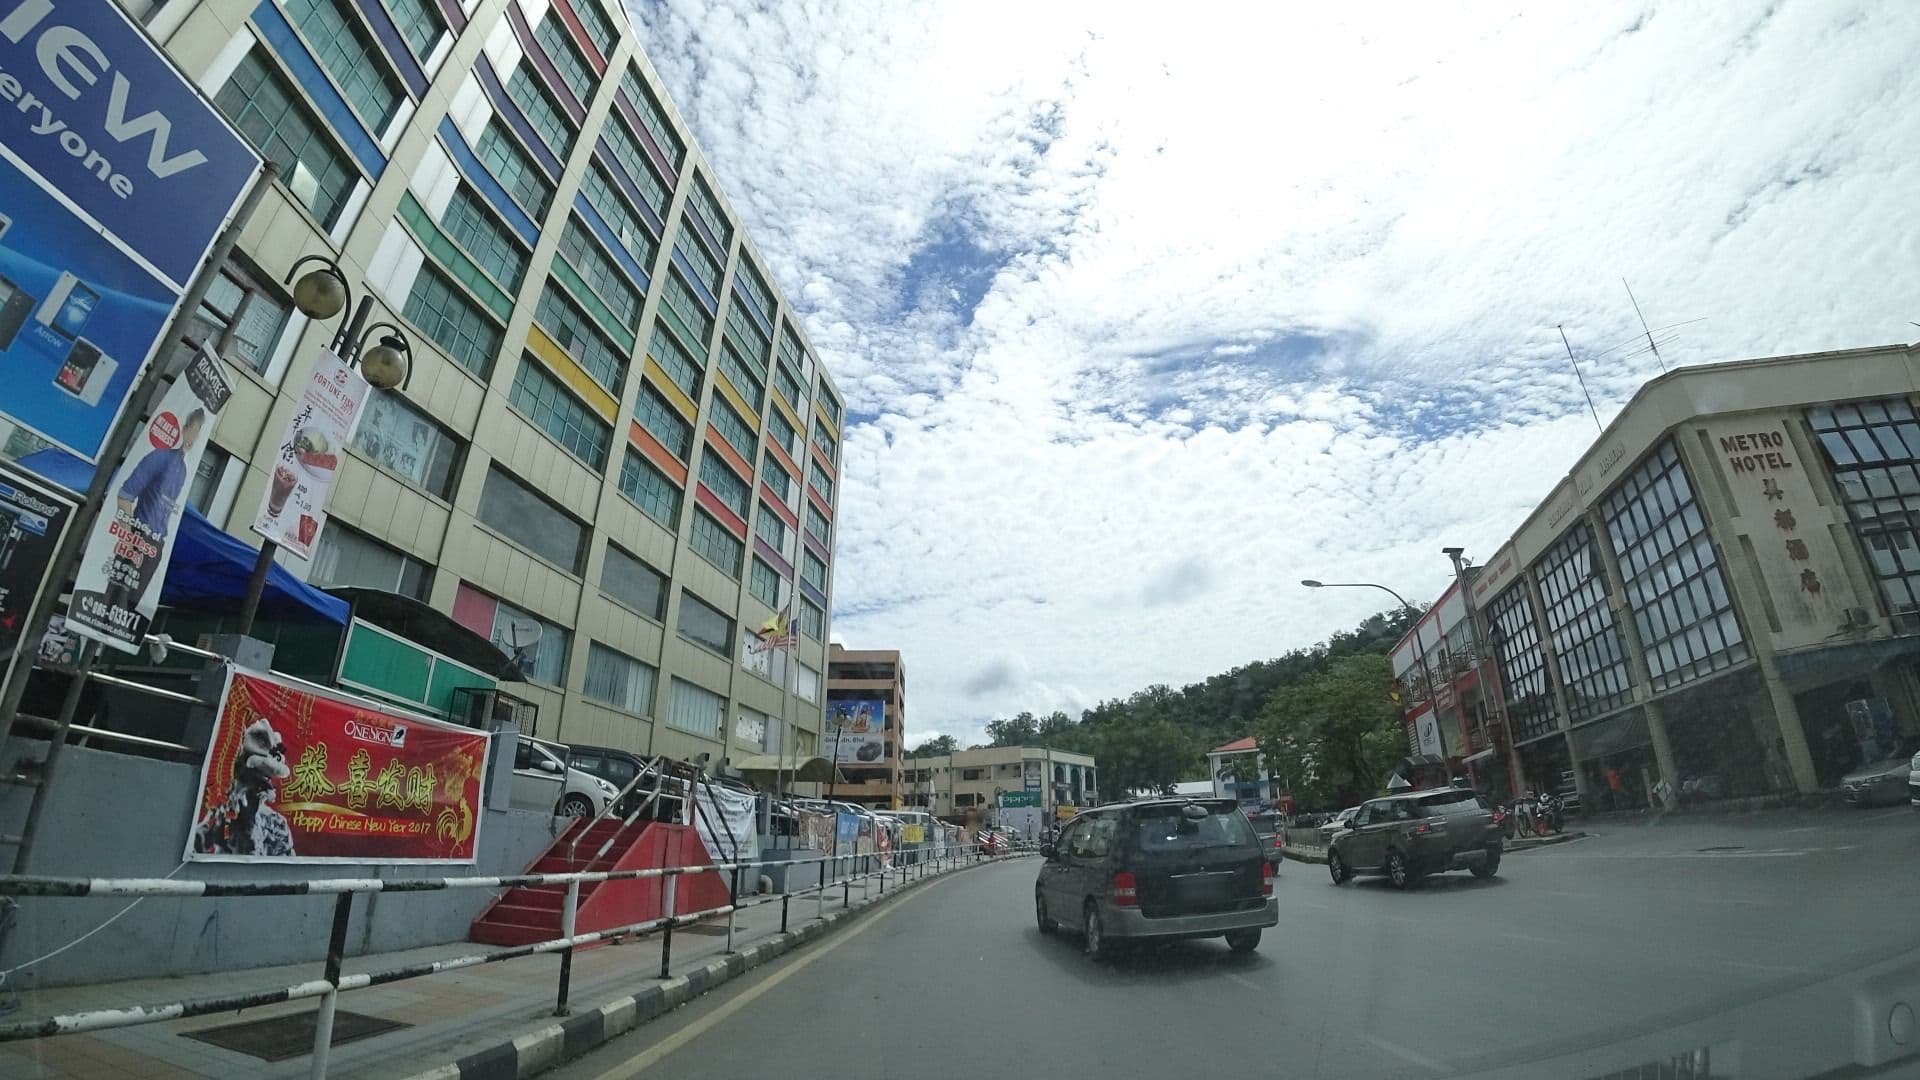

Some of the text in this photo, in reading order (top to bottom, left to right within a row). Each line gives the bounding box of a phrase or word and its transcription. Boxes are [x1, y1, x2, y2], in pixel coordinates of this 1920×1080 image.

[0, 0, 208, 179] IEW
[0, 67, 134, 200] eryone
[313, 371, 341, 399] FORTUNE
[1720, 431, 1784, 454] METRO
[1729, 452, 1792, 475] HOTEL
[293, 811, 431, 834] Happy Chinese New Year 2017
